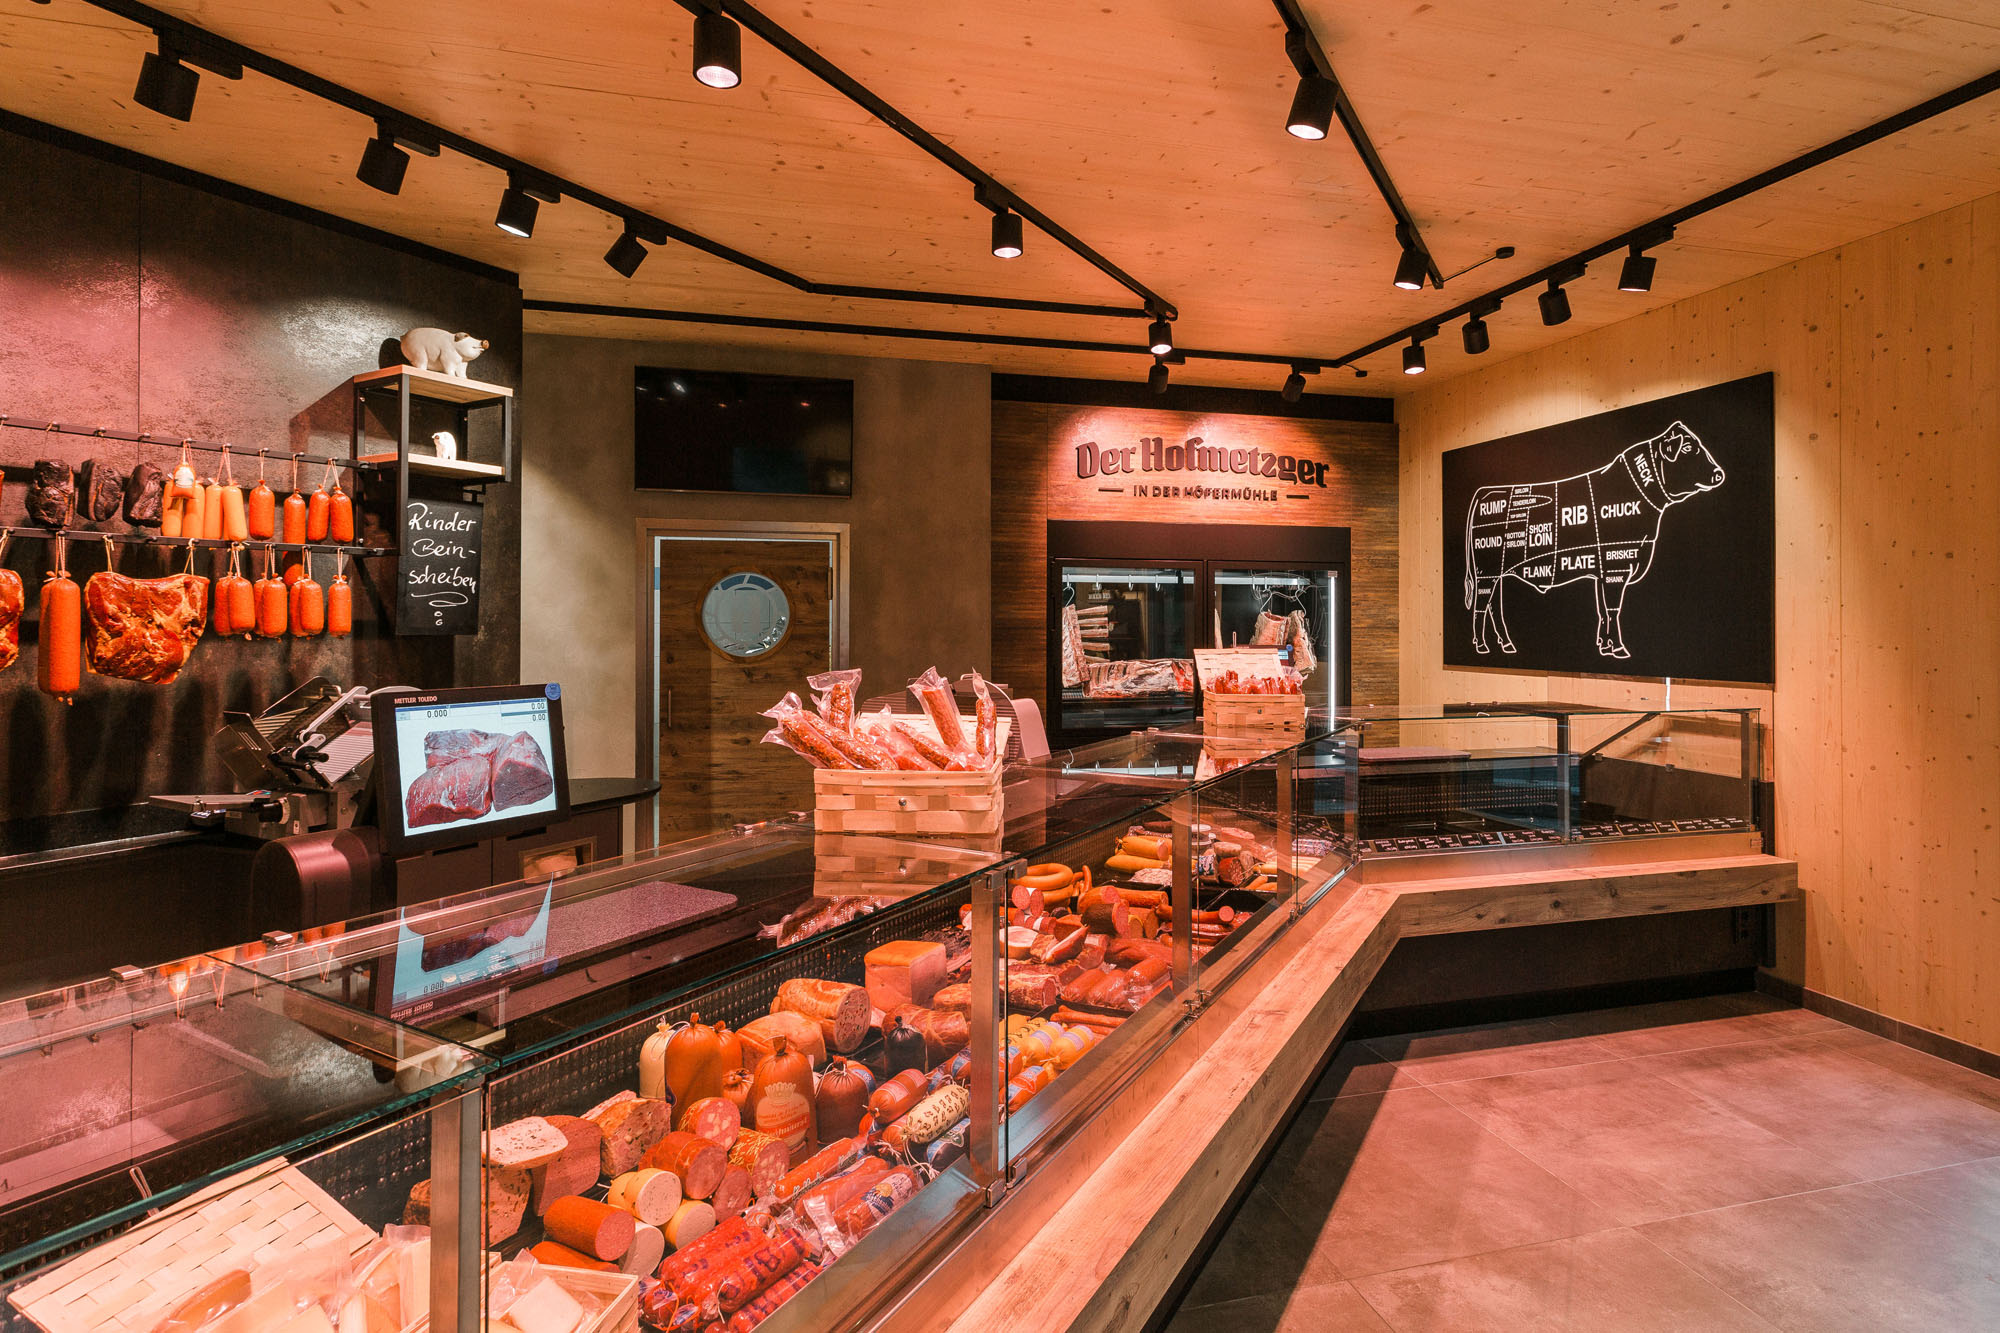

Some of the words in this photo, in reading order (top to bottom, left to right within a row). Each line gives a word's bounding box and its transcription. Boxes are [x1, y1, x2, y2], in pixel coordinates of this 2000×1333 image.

[1075, 441, 1136, 480] Der
[1140, 436, 1330, 488] Hofmetzger
[1634, 453, 1655, 487] NECK
[1133, 485, 1148, 497] IN
[1152, 485, 1180, 498] DER
[1184, 485, 1278, 501] HÖFERMÜHLE
[1480, 500, 1507, 516] RUMP
[1600, 501, 1641, 519] CHUCK
[407, 502, 477, 532] Rinder
[1561, 505, 1588, 527] RIB
[1506, 531, 1526, 540] BOTTOM
[1529, 522, 1553, 535] SHORT
[1474, 536, 1503, 549] ROUND
[1506, 539, 1526, 548] SIRLOIN
[1529, 532, 1553, 547] LOIN
[1606, 549, 1639, 561] BRISKET
[1561, 555, 1596, 571] PLATE
[1523, 565, 1552, 578] FLANK
[1605, 576, 1624, 584] SHANK
